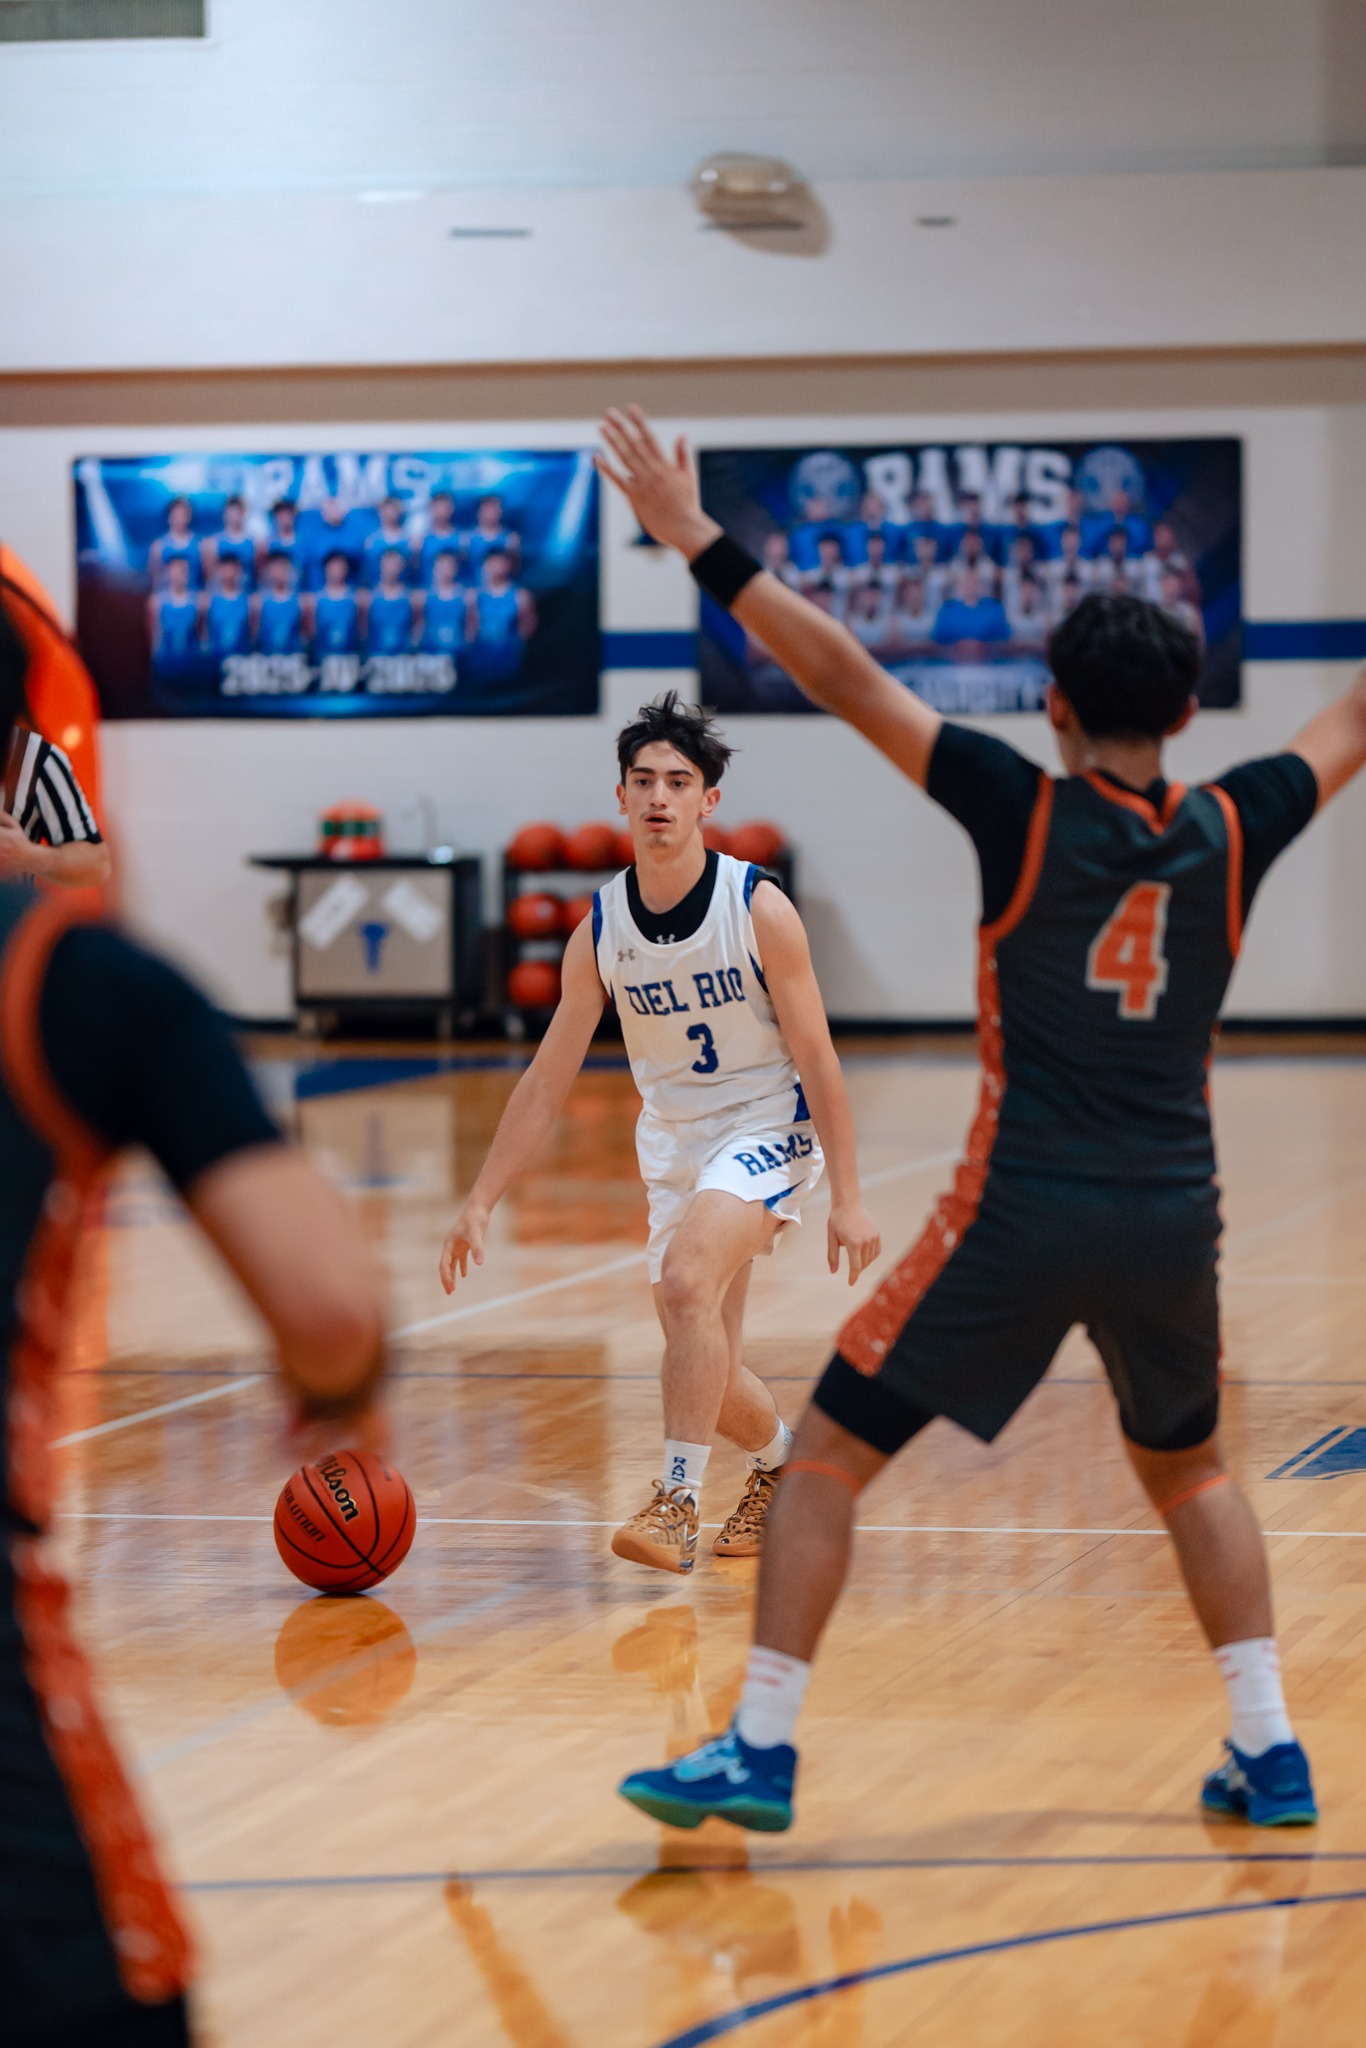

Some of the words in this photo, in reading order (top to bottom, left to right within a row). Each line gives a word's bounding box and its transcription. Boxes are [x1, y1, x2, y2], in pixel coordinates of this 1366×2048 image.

[864, 446, 1072, 526] RAMS
[1084, 879, 1172, 1022] 4
[624, 979, 689, 1016] DEL
[692, 967, 746, 1010] RIO
[686, 1022, 719, 1074] 3
[732, 1132, 814, 1176] RAMS
